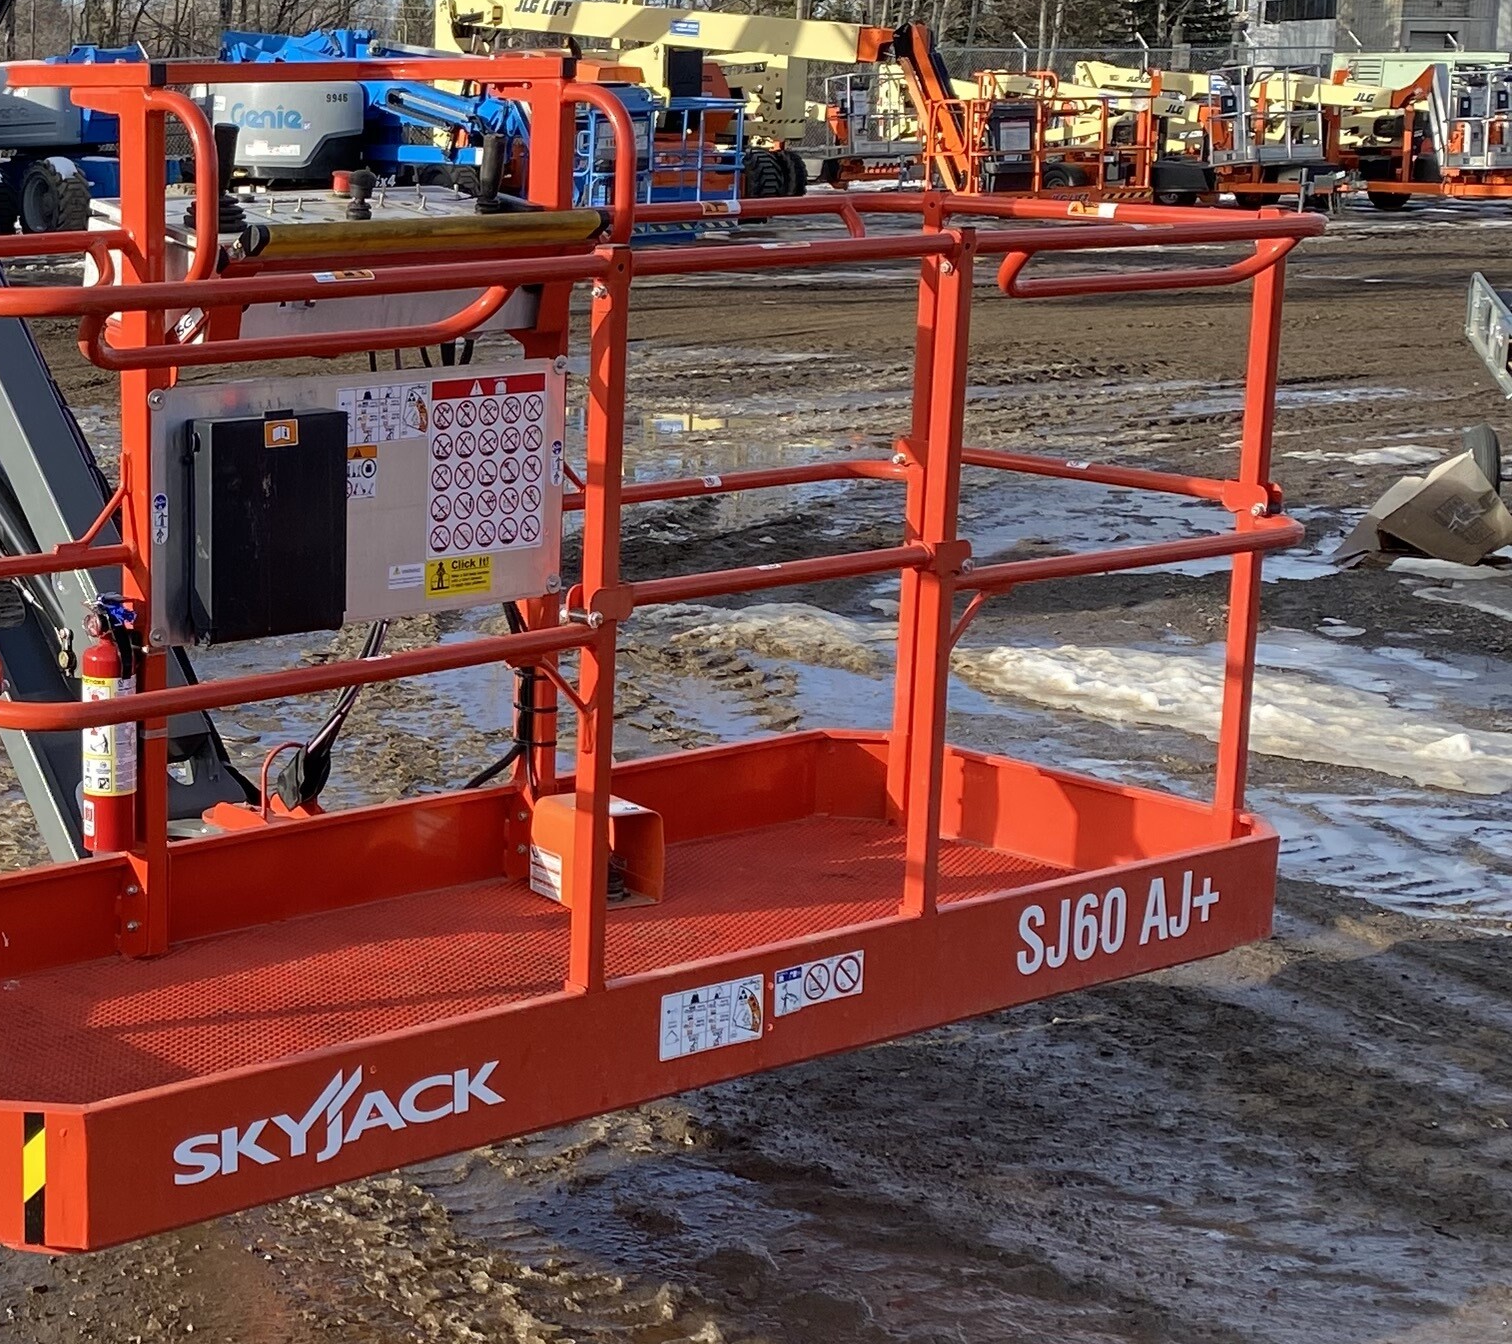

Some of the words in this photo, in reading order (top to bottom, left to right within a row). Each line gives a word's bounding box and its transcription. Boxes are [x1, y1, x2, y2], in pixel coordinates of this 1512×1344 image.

[541, 0, 573, 17] LIFT
[230, 102, 303, 129] Genie
[1165, 104, 1185, 115] JLG
[451, 560, 476, 570] Click
[1016, 886, 1128, 976] SJ60
[1138, 870, 1220, 946] AJ+
[173, 1060, 507, 1186] SKYJACK
